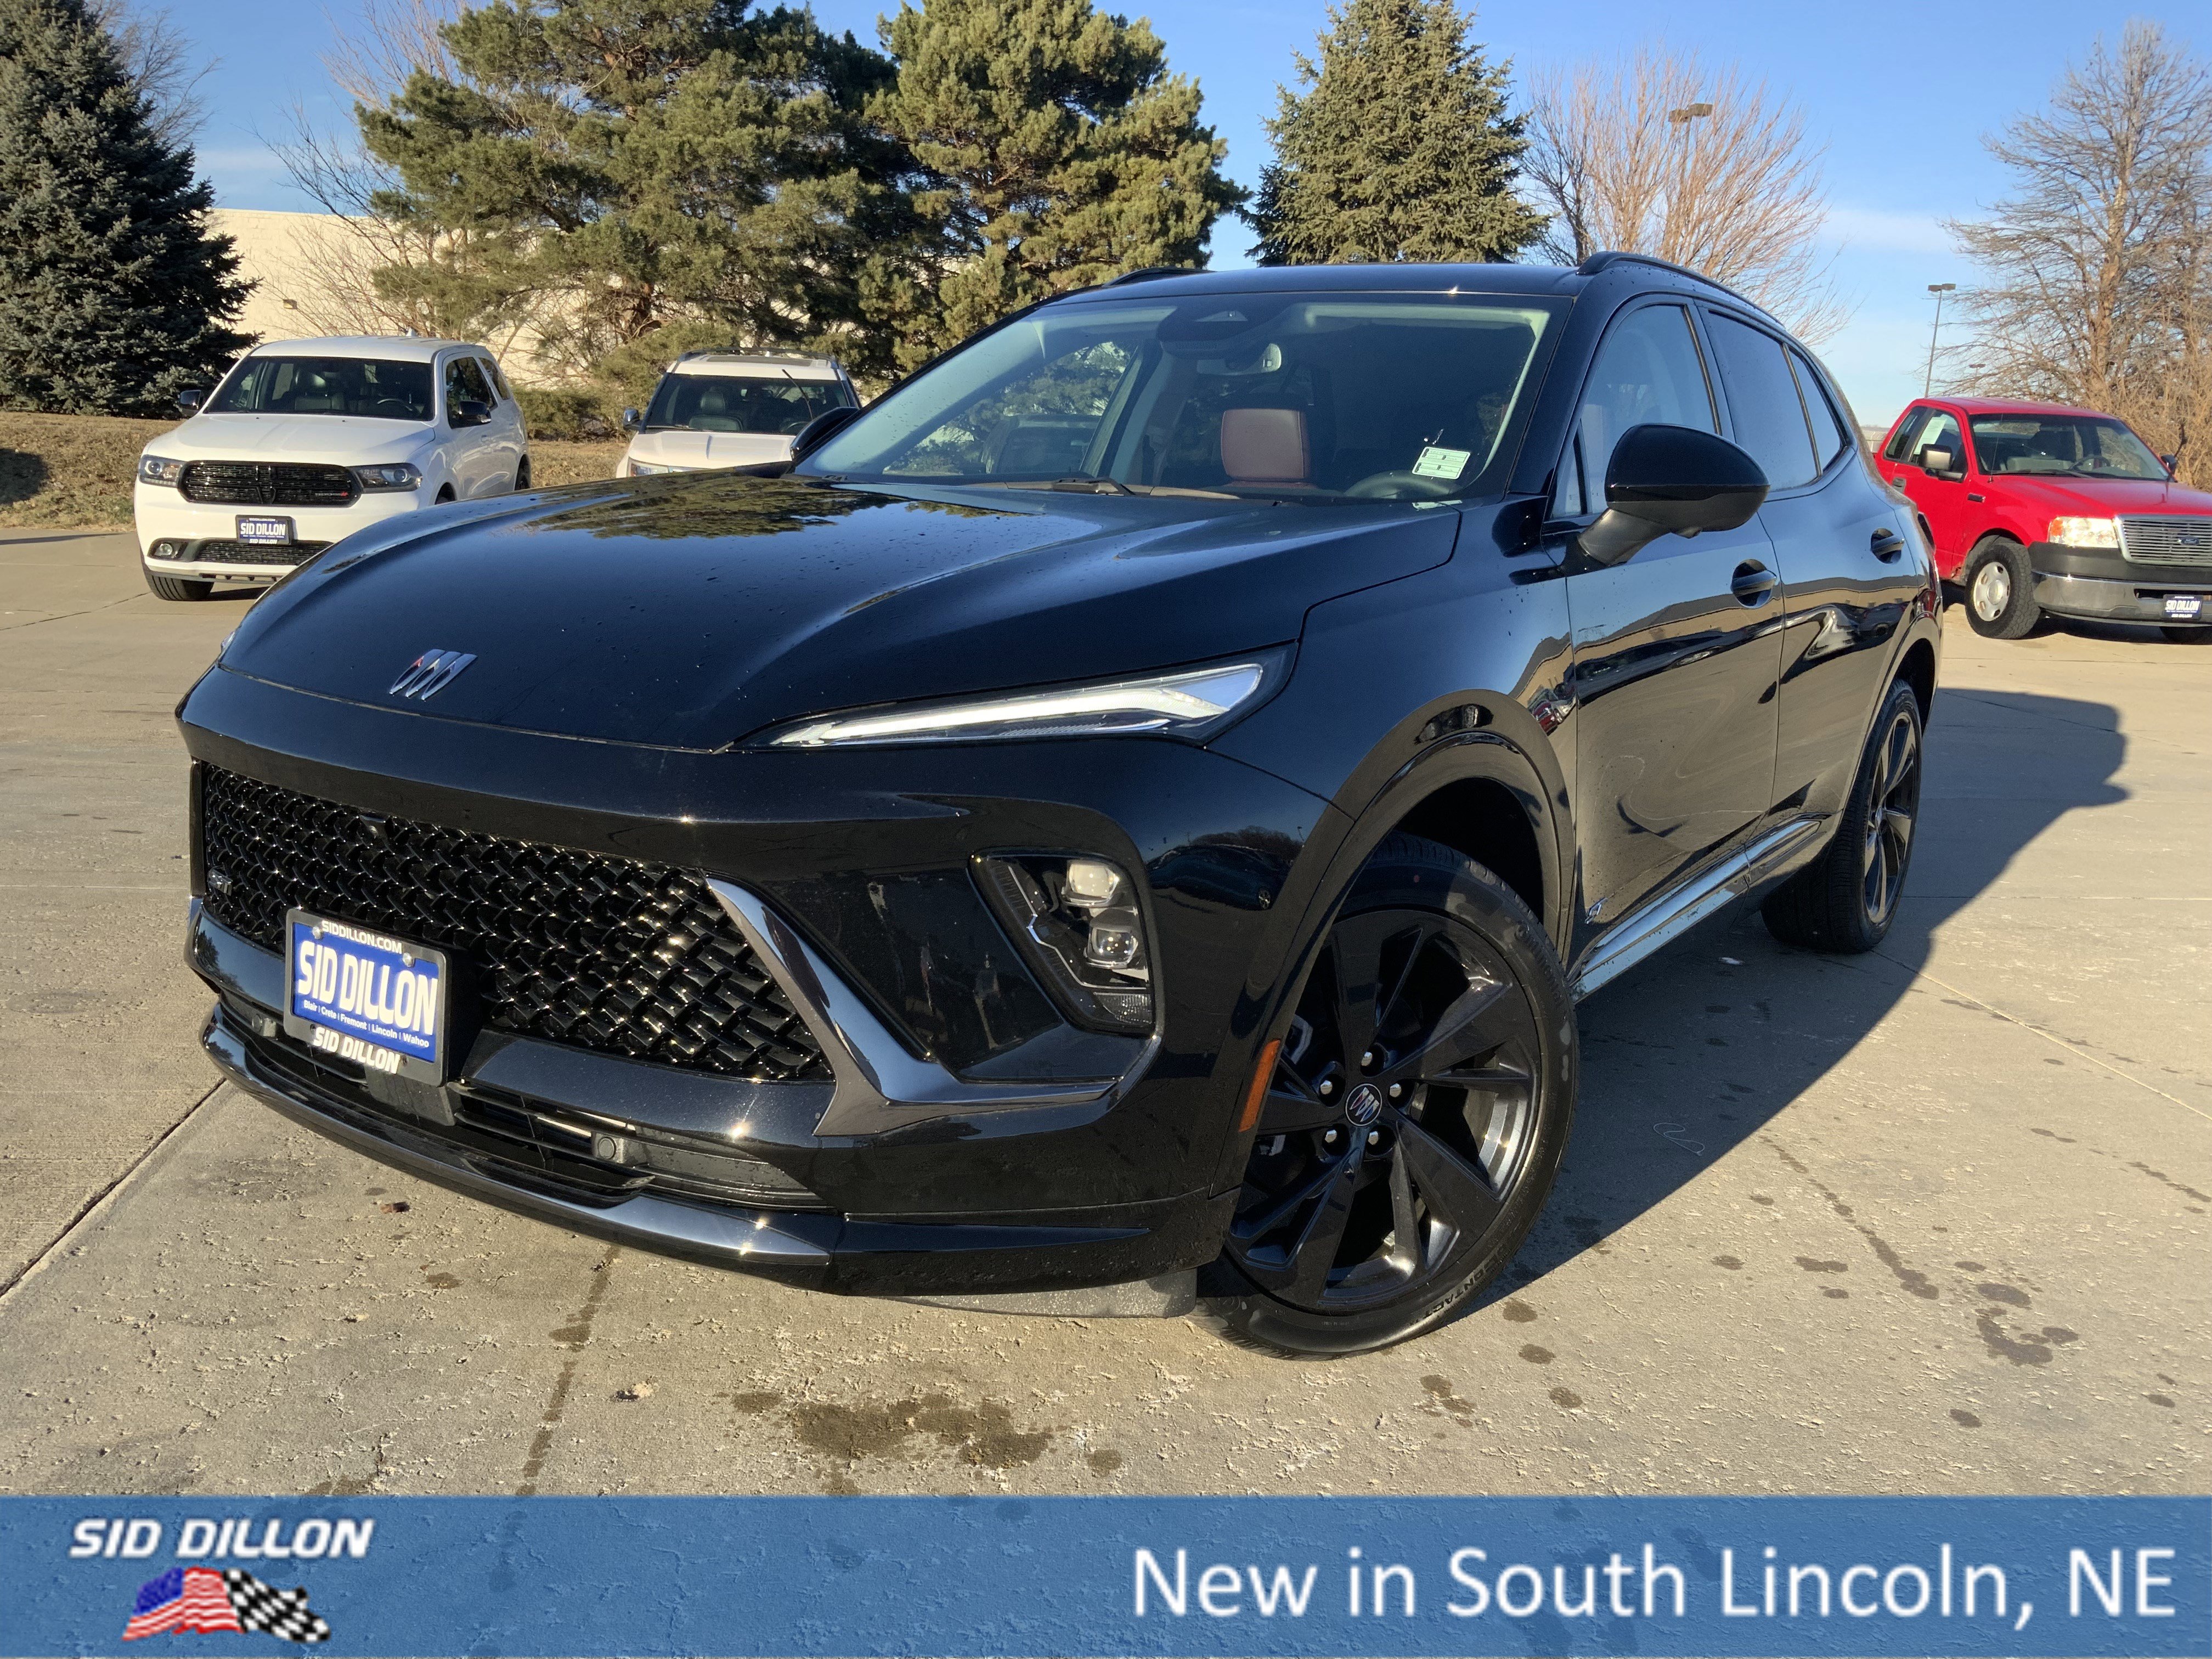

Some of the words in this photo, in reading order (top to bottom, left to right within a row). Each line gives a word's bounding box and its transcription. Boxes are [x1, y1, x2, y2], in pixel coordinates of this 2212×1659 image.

[240, 522, 255, 535] SID
[256, 523, 286, 535] DILLON
[2165, 600, 2177, 611] SID
[2176, 600, 2200, 611] DILLON
[321, 919, 402, 954] SIDDILLON.COM
[298, 940, 338, 1005] SID
[340, 953, 439, 1036] DILLON
[303, 999, 318, 1011] Blair
[321, 1002, 337, 1019] Crete
[340, 1014, 368, 1031] Fremont
[372, 1024, 398, 1040] Lincoln
[403, 1032, 430, 1048] Wahoo
[313, 1026, 340, 1053] SID
[341, 1037, 401, 1074] DILLON
